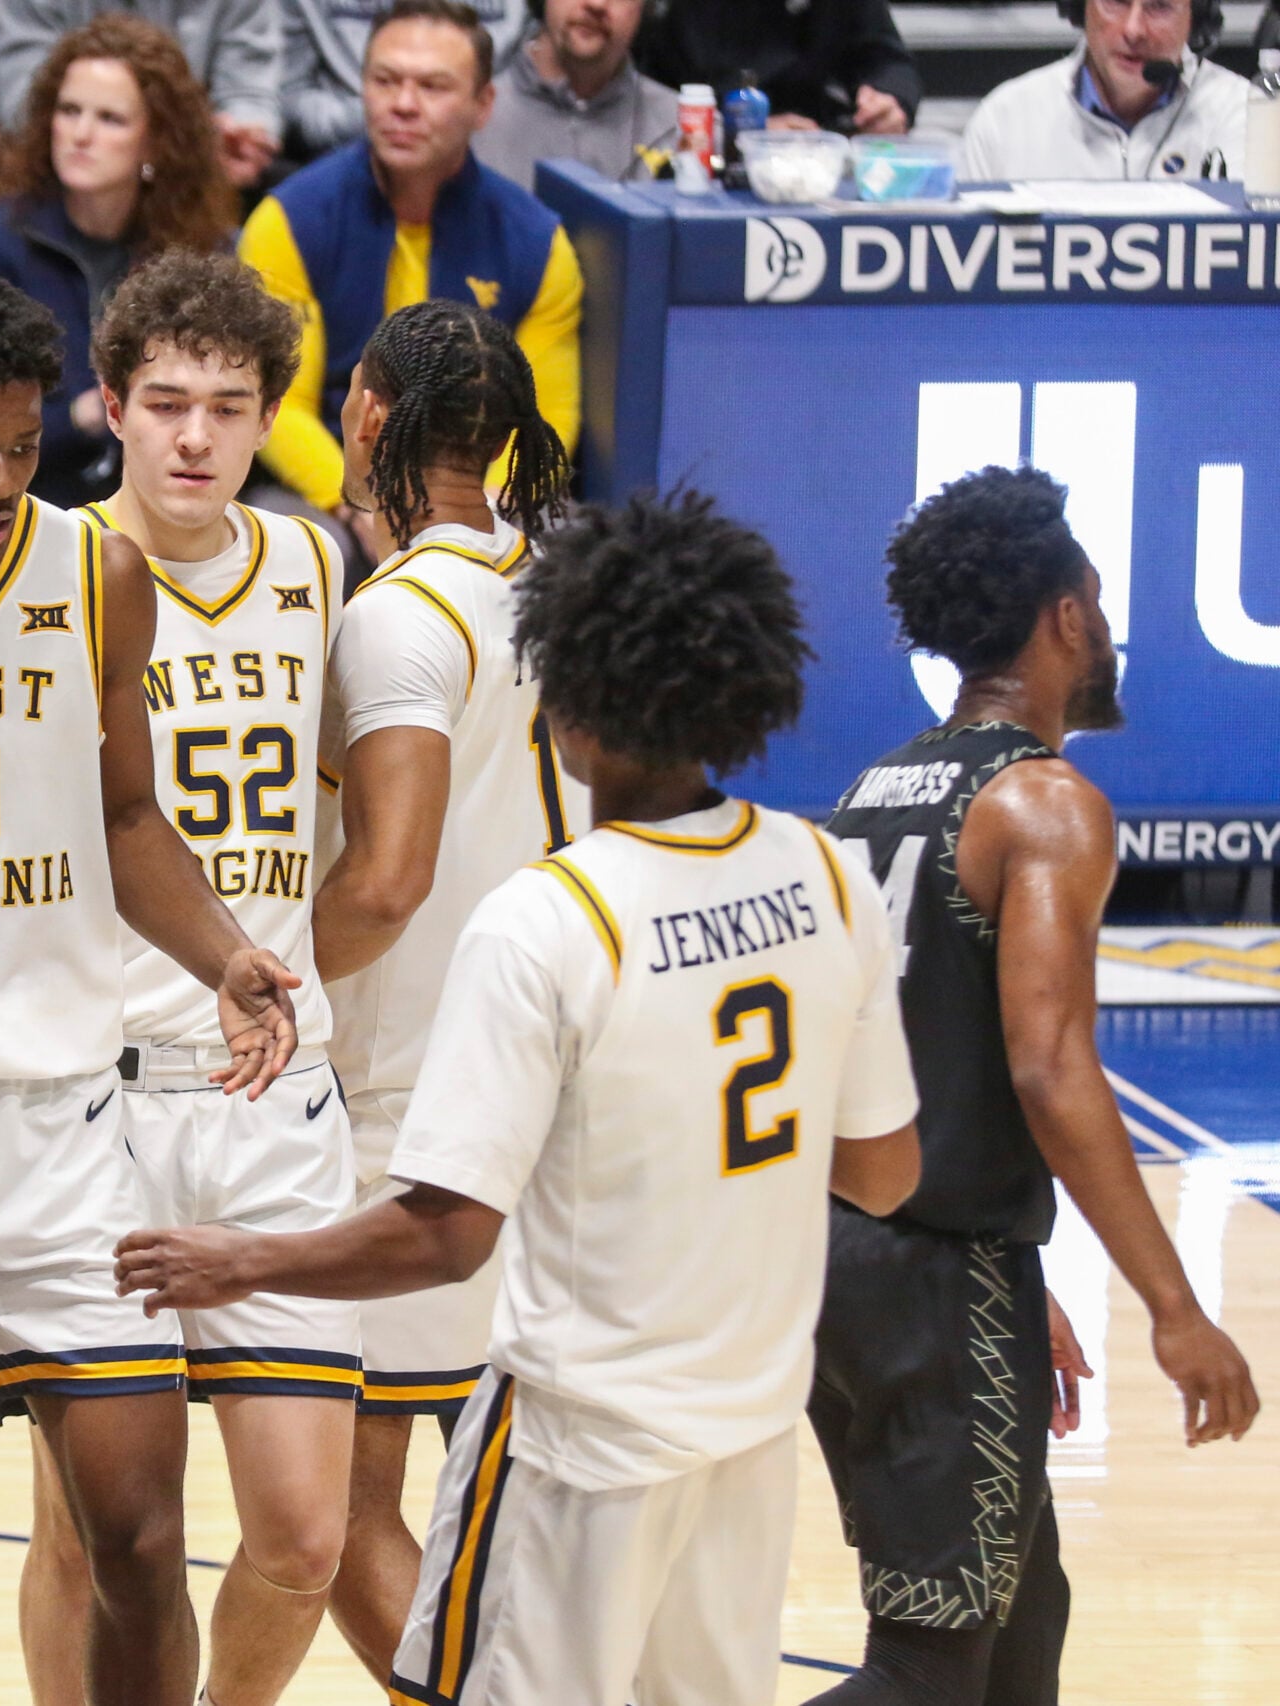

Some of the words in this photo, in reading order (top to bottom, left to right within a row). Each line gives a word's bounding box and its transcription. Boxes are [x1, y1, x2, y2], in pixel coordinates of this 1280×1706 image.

[841, 222, 1280, 293] DIVERSIFI
[20, 602, 72, 633] XII
[272, 584, 316, 611] XII
[142, 651, 304, 715] WEST
[172, 723, 298, 840] 52
[193, 847, 309, 901] GINI
[1117, 821, 1280, 862] NERGY
[650, 882, 817, 973] JENKINS
[837, 835, 928, 976] 4
[709, 973, 800, 1178] 2
